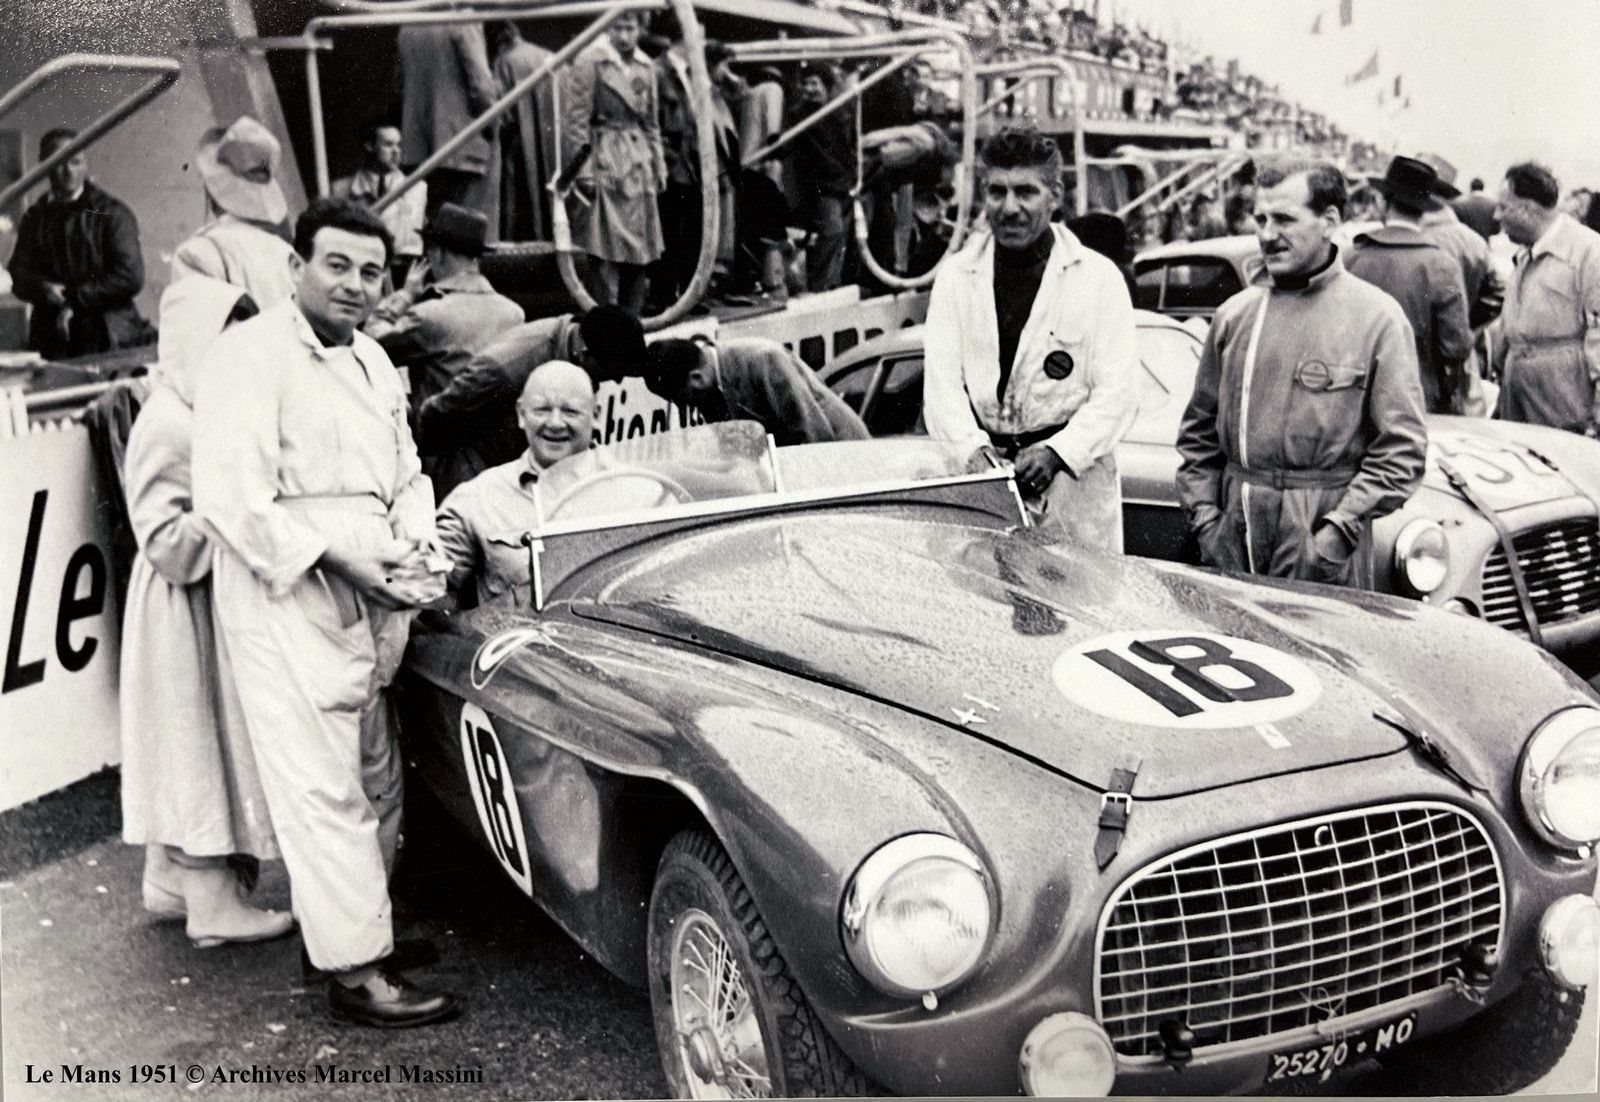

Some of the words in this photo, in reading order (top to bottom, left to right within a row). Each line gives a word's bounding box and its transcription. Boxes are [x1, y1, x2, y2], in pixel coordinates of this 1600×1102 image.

[2, 489, 107, 694] Le
[1082, 636, 1295, 718] 18
[465, 719, 525, 877] 18
[1271, 1041, 1348, 1078] 25270
[1375, 1018, 1413, 1052] MO
